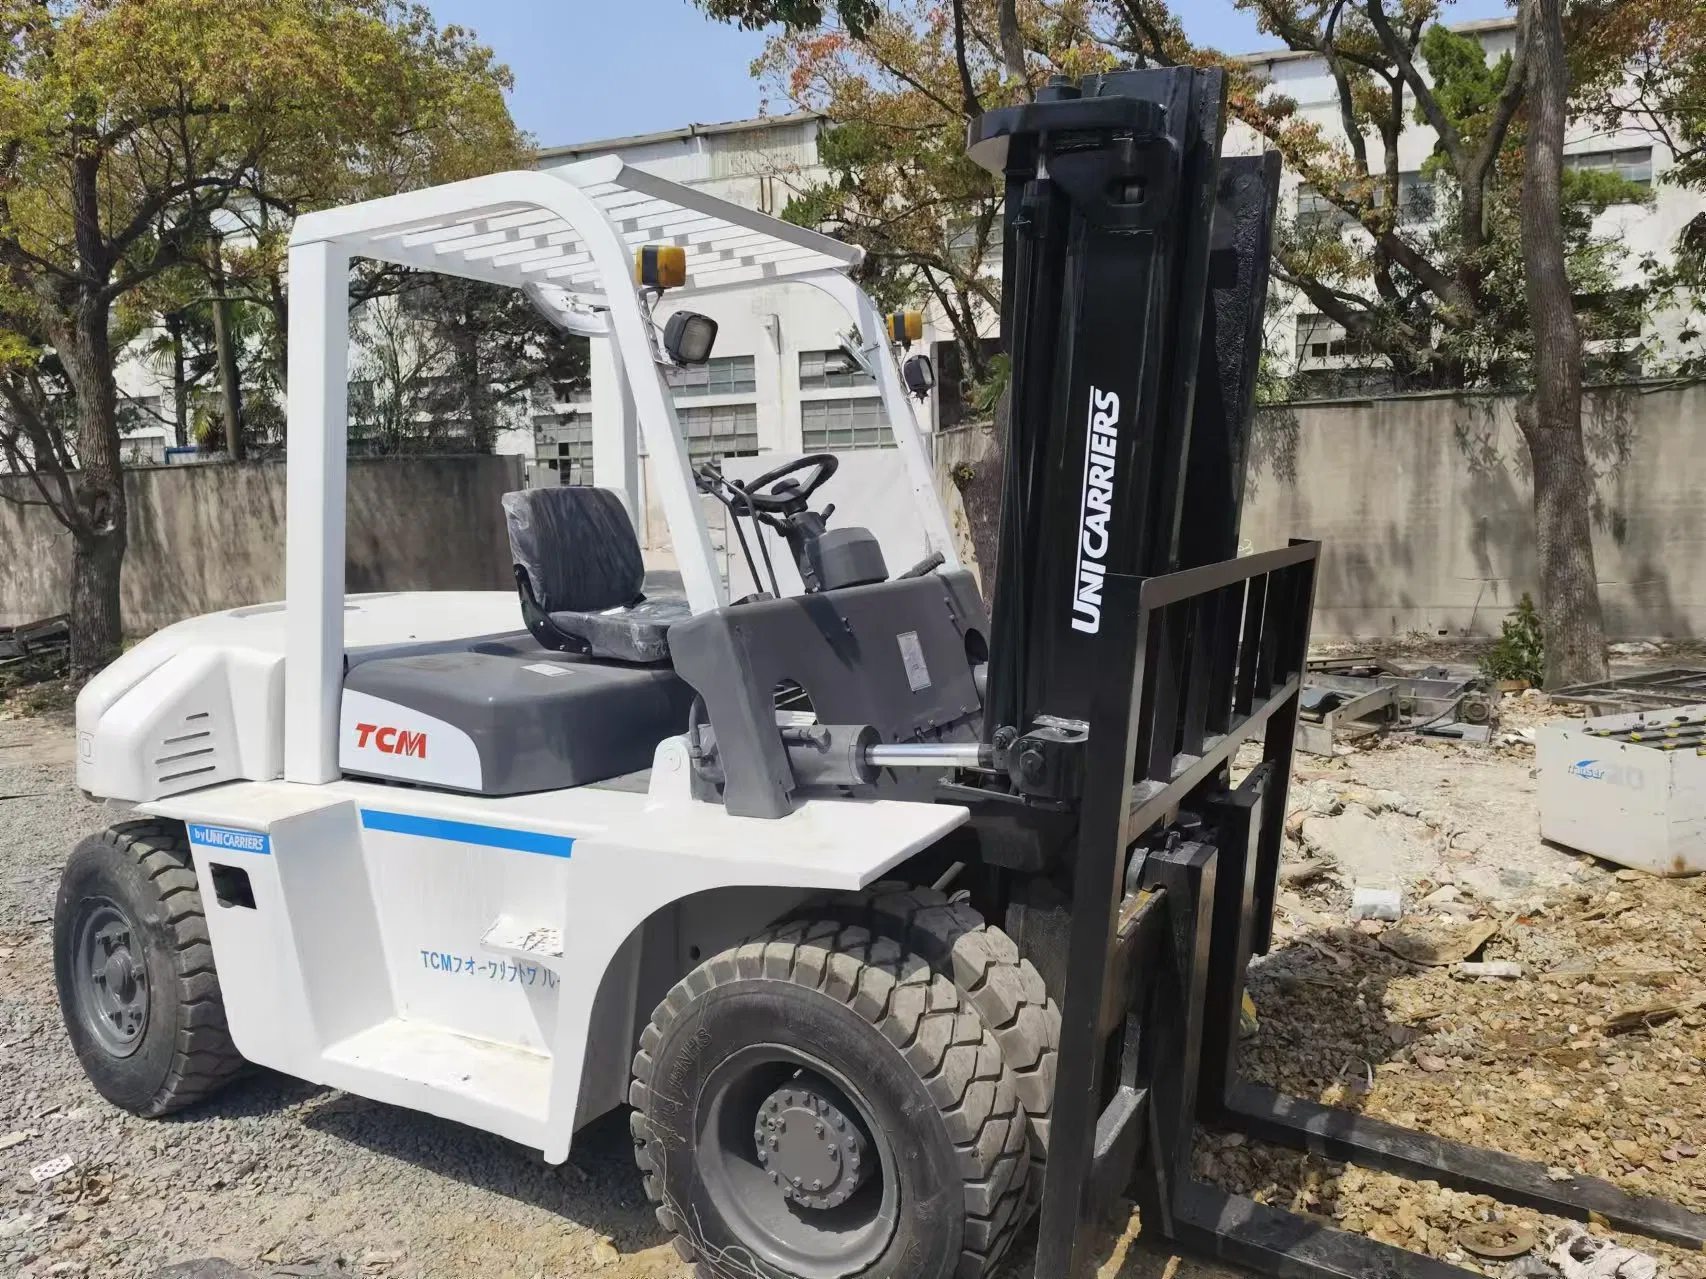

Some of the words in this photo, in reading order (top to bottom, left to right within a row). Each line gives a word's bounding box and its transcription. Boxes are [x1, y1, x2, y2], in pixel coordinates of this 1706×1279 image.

[1071, 385, 1120, 634] UNICARRIERS
[356, 722, 427, 759] TCM
[194, 828, 205, 841] by
[205, 829, 264, 850] UNICARRIERS
